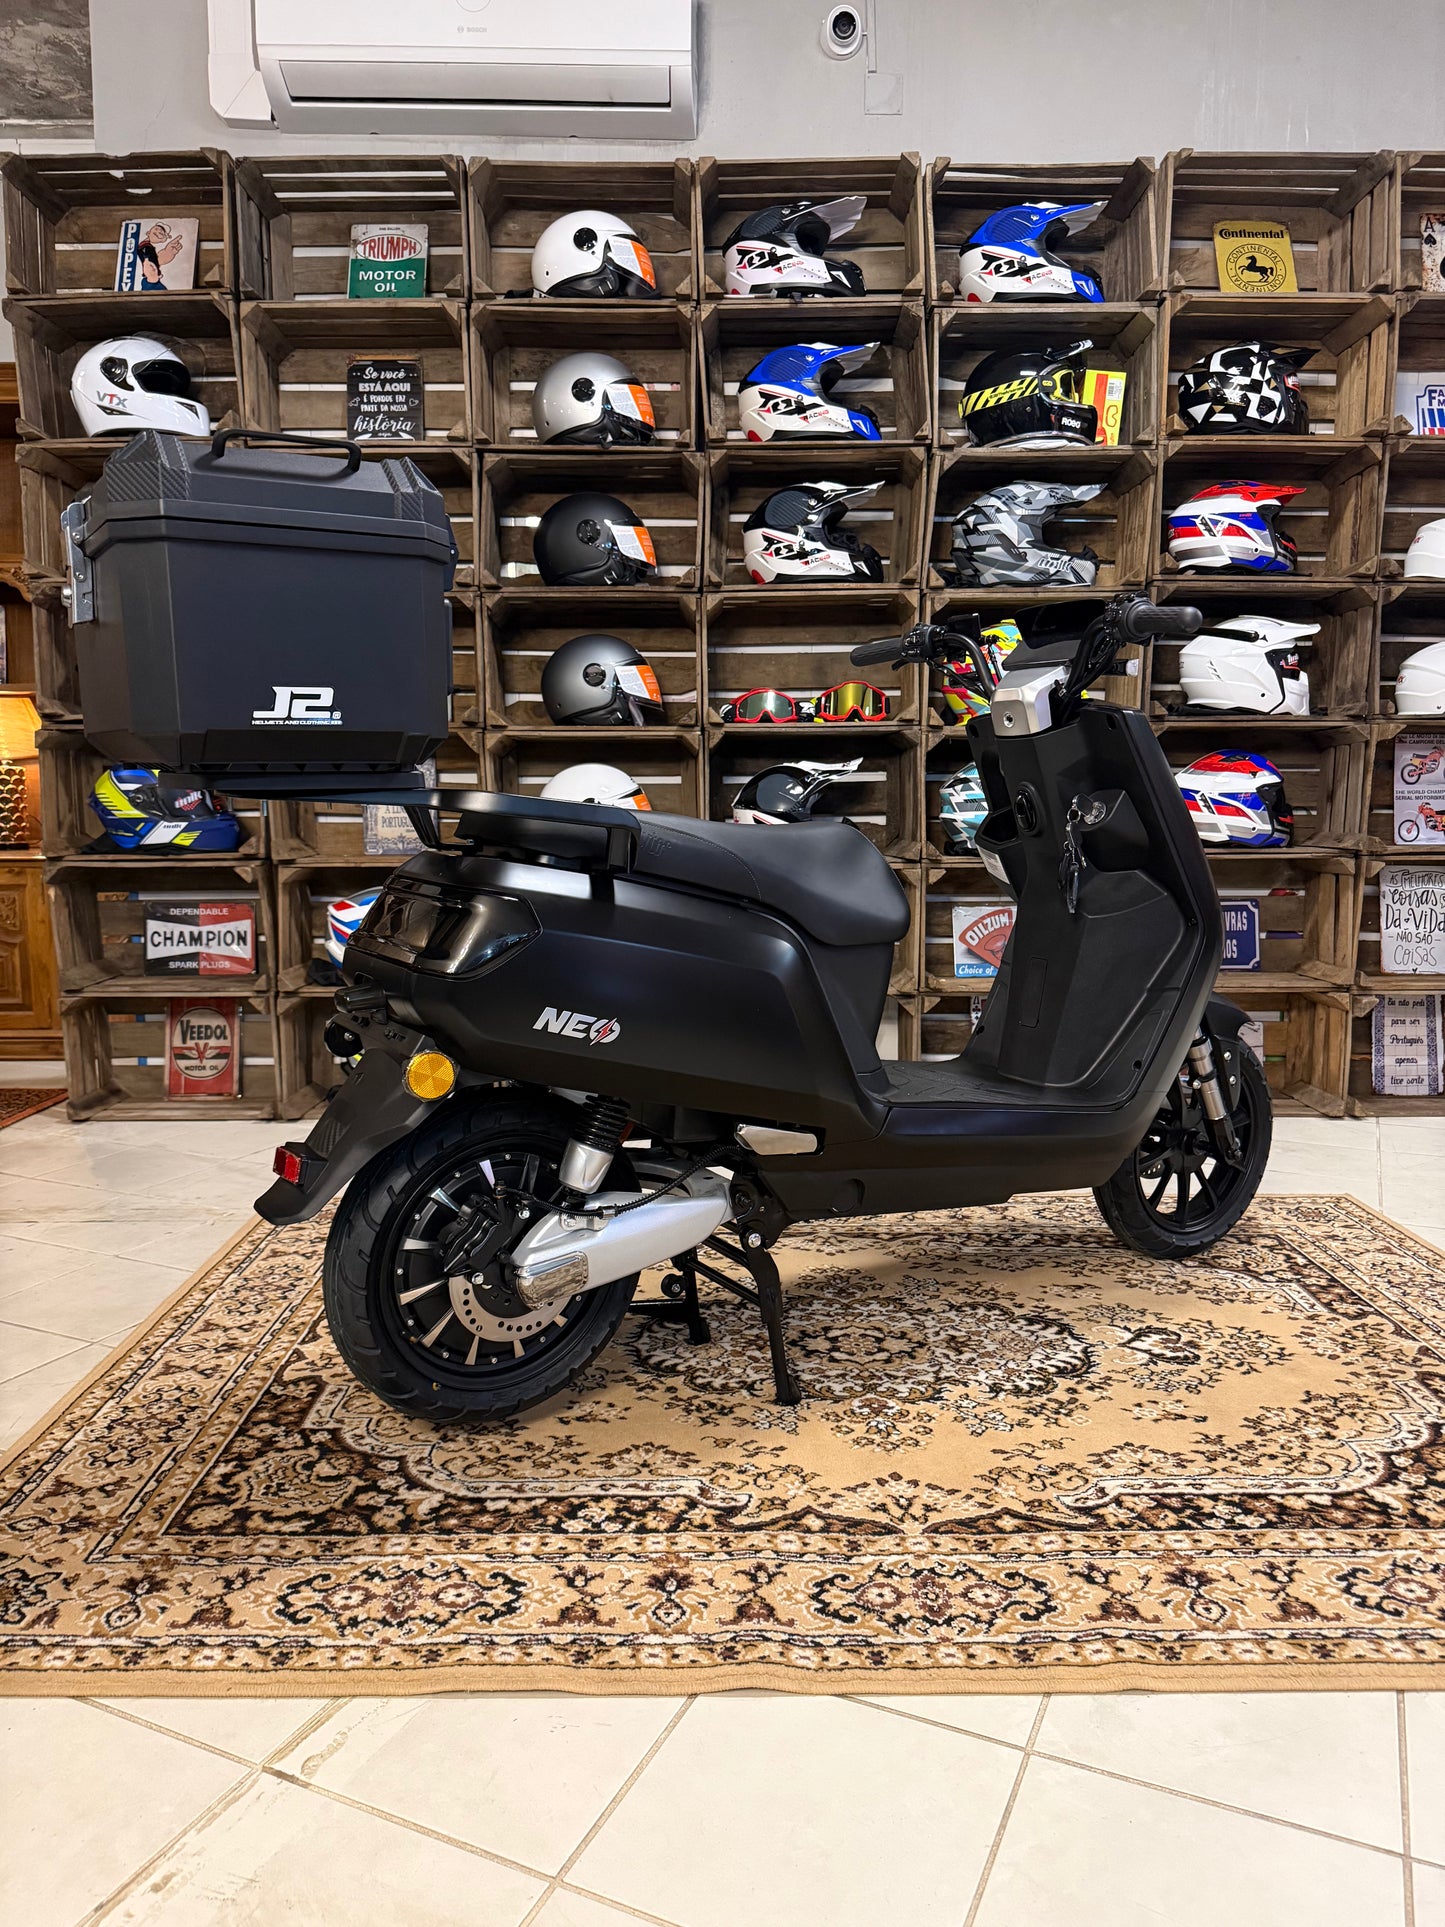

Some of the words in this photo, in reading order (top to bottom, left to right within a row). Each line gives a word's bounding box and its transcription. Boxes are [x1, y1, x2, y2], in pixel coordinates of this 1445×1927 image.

[1424, 216, 1435, 232] A
[1219, 229, 1284, 239] Continental
[361, 236, 417, 260] TRIUMPH
[1229, 245, 1281, 264] CONTINENTAL
[359, 271, 416, 280] MOTOR
[374, 283, 397, 292] OIL
[363, 367, 379, 379] Se
[381, 369, 406, 379] você
[359, 381, 383, 391] ESTÁ
[384, 383, 411, 391] AQUI
[96, 391, 128, 408] VTX
[354, 413, 416, 432] história
[1390, 874, 1399, 885] AS
[1404, 872, 1444, 888] MELHORES
[1222, 911, 1247, 931] VRAS
[965, 912, 1009, 946] OILZUM
[150, 930, 248, 948] CHAMPION
[1396, 928, 1412, 943] NÃO
[1415, 931, 1432, 945] SÃO
[200, 961, 230, 969] PLUGS
[958, 966, 983, 974] Choice
[986, 966, 994, 976] of
[1388, 998, 1395, 1006] Eu
[1413, 999, 1425, 1009] pedi
[1391, 1019, 1406, 1027] para
[180, 1019, 228, 1045] VEEDOL
[1395, 1058, 1418, 1067] apenas
[1391, 1076, 1404, 1085] tive
[1406, 1076, 1424, 1085] sorte
